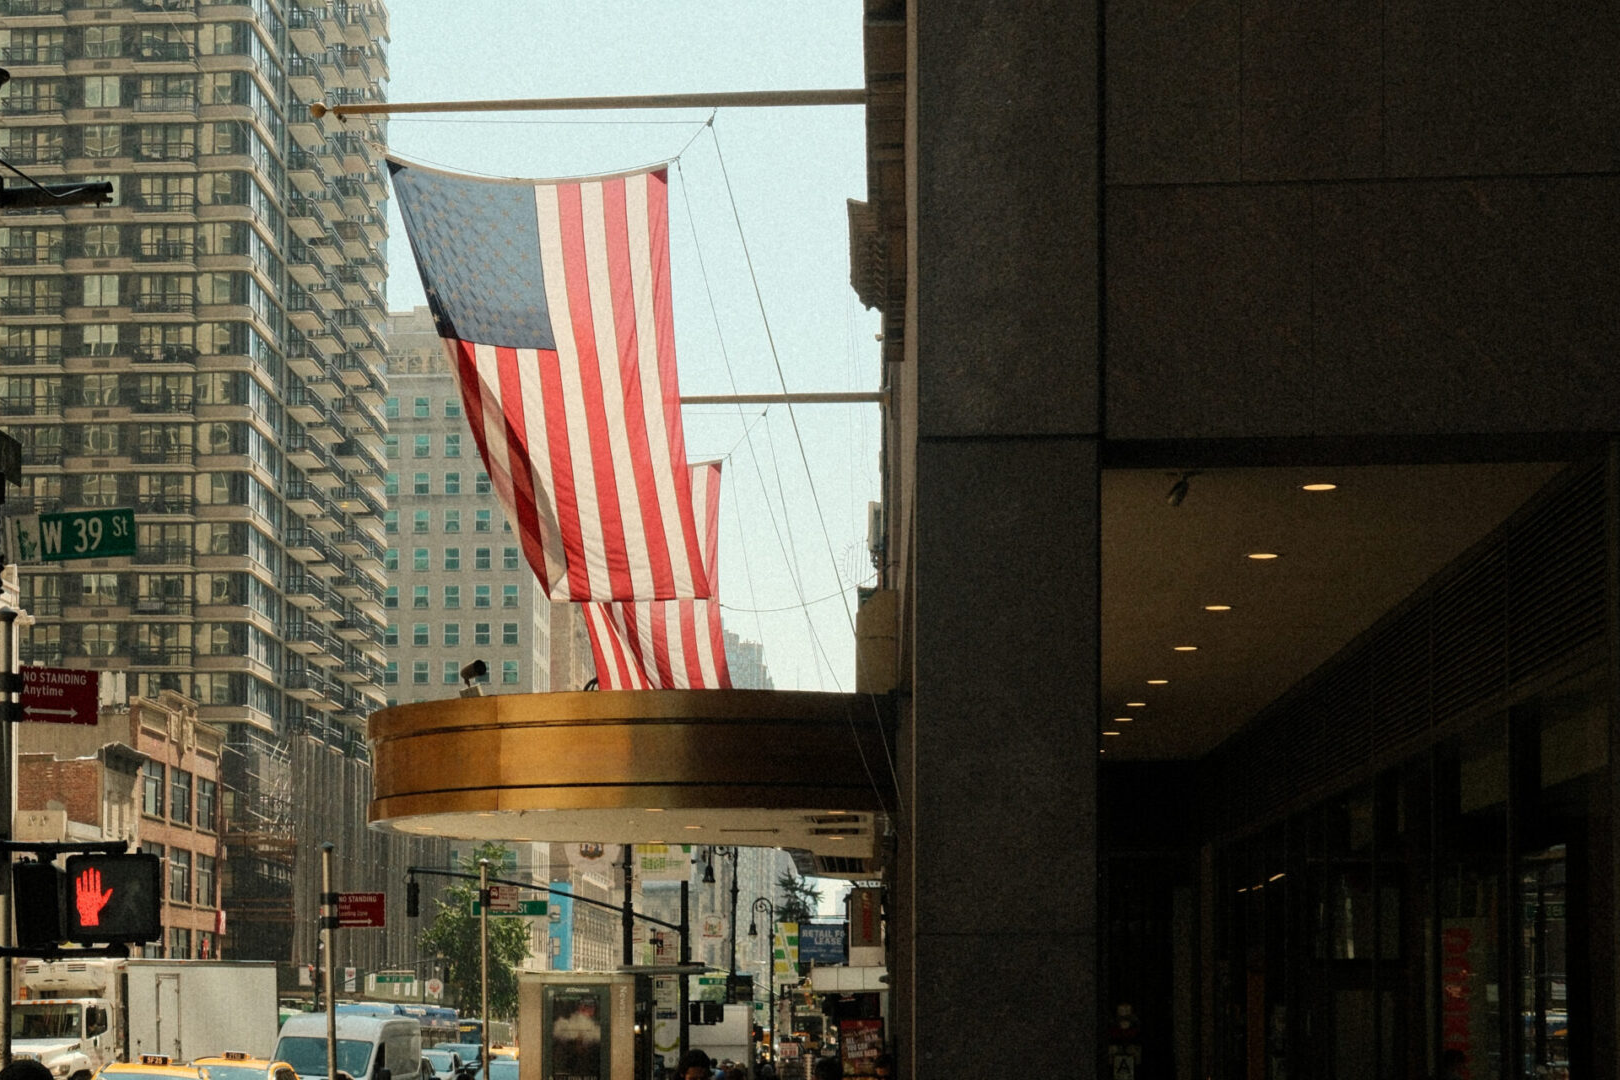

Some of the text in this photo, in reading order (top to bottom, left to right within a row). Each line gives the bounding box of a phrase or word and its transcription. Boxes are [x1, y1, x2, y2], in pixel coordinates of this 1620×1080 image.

[42, 515, 128, 554] W 39 St
[23, 671, 87, 686] NO STANDING
[23, 684, 64, 698] Anytime
[348, 895, 377, 903] STANDING
[518, 903, 528, 914] St
[802, 929, 833, 938] RETAIL
[814, 937, 842, 945] LEASE
